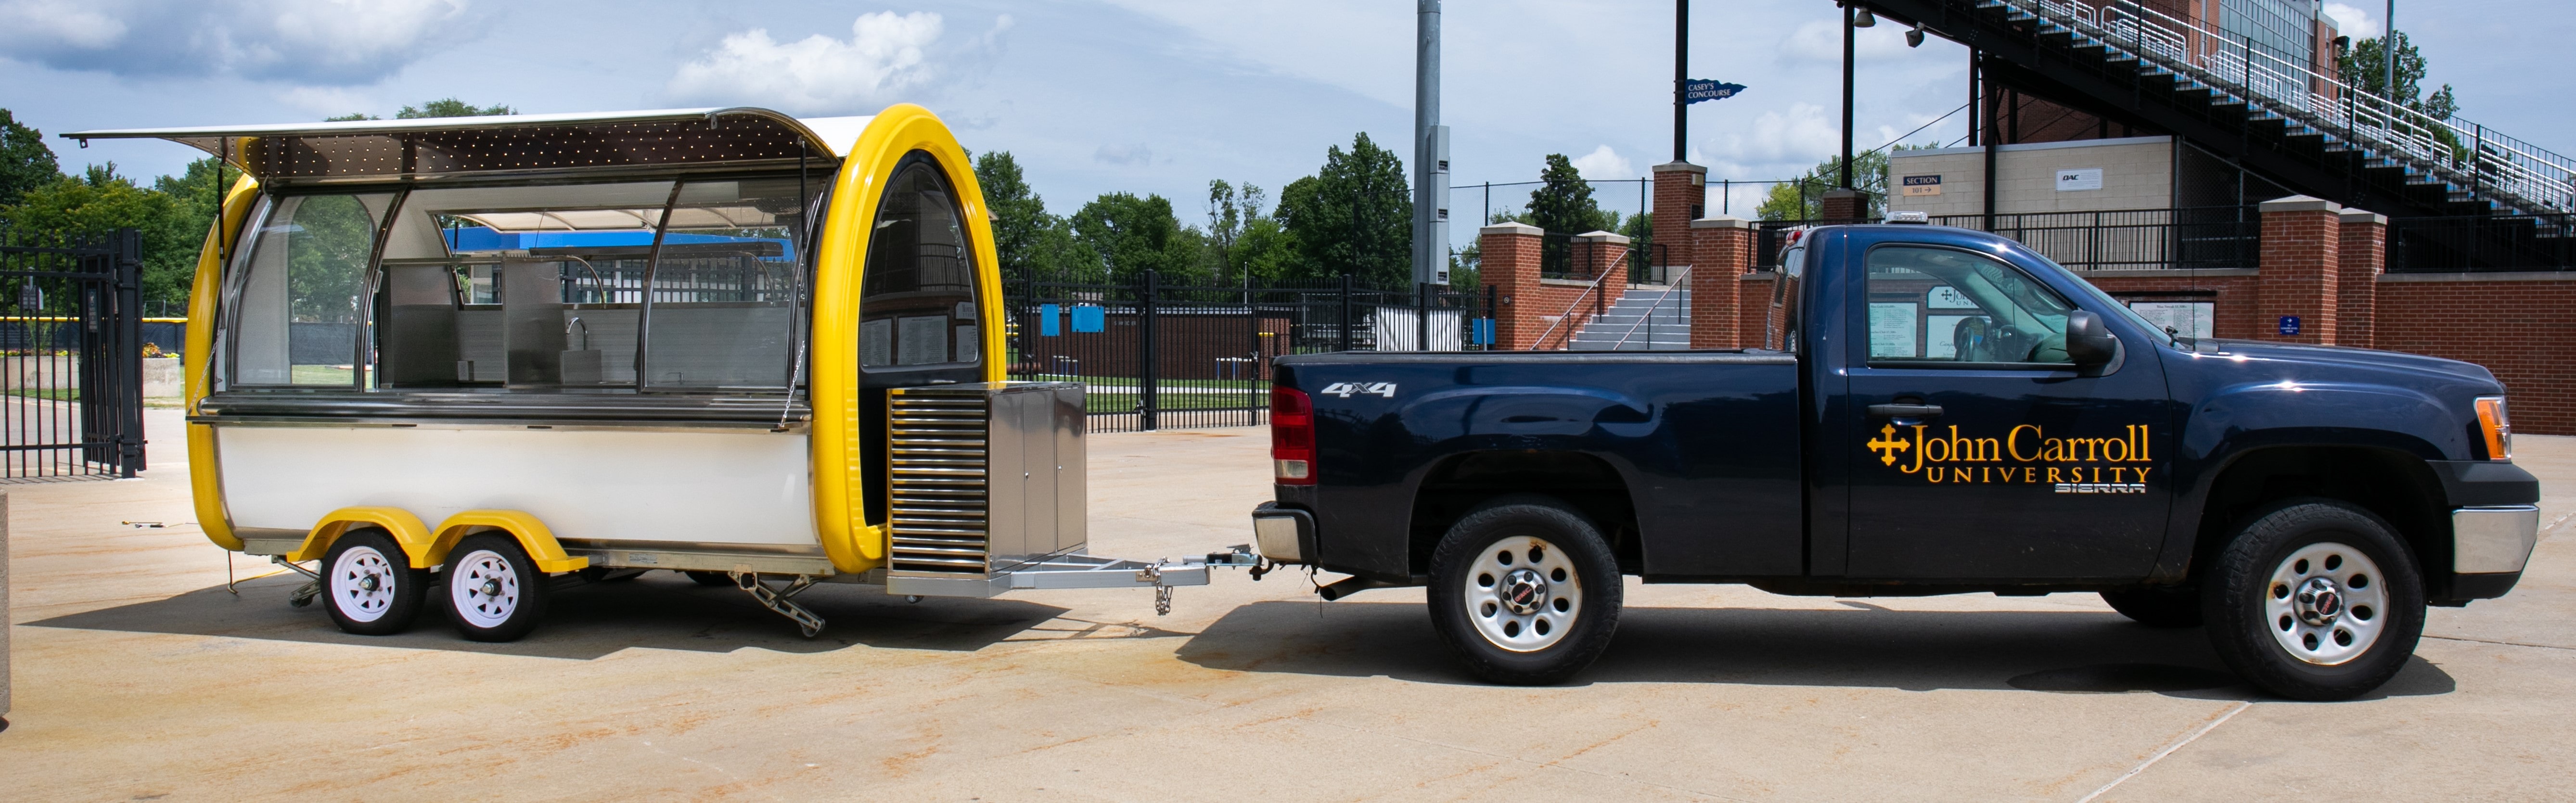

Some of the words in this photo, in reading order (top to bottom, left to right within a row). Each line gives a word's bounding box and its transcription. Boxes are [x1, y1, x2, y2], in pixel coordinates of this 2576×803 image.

[1688, 83, 1714, 91] CASEY'S
[1688, 89, 1731, 99] CONCOURSE
[1901, 425, 2002, 473] John
[2007, 424, 2152, 462] Carroll
[1927, 467, 2152, 483] UNIVERSITY
[2054, 483, 2146, 494] SIERRA
[1514, 586, 1532, 602] GMC
[2320, 594, 2334, 614] GMC
